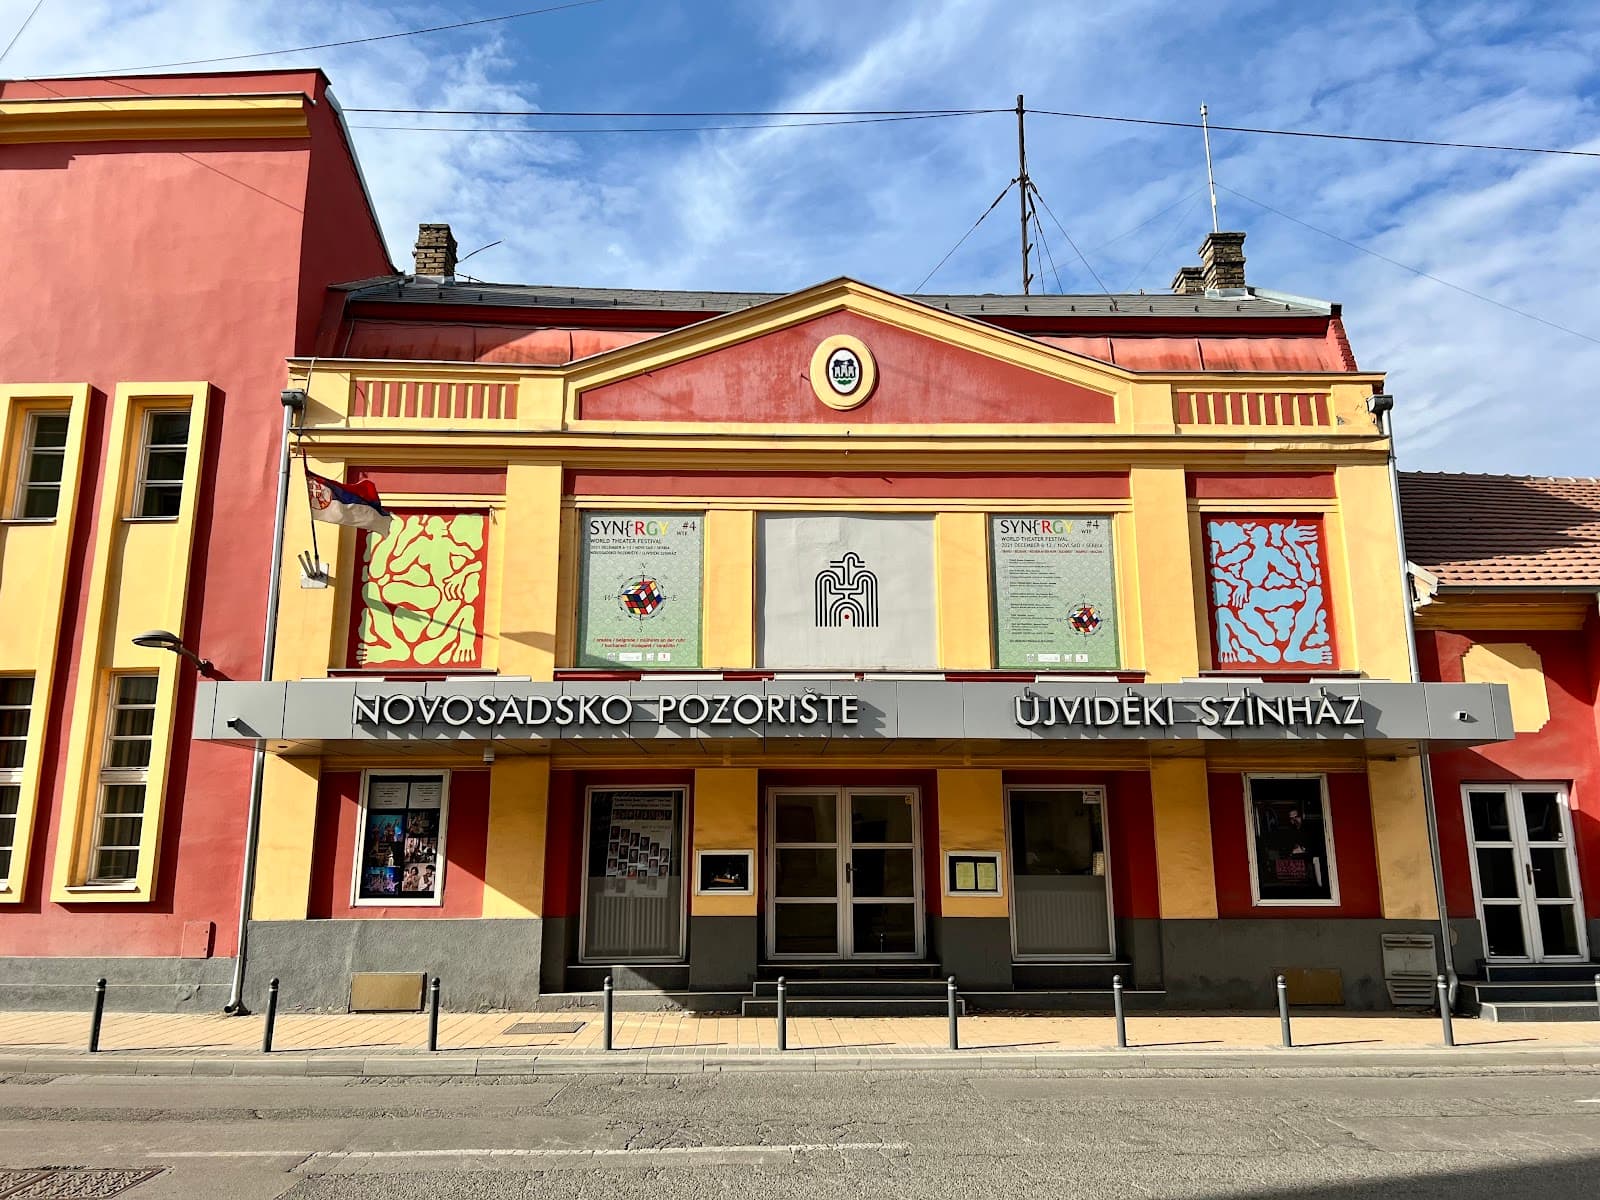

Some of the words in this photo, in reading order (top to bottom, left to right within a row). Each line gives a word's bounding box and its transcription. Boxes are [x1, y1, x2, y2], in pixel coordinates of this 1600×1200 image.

[682, 521, 697, 532] #4
[1086, 519, 1100, 529] #4
[352, 694, 633, 726] NOVOSADSKO
[658, 687, 859, 725] POZORIŠTE
[1014, 687, 1175, 726] ÚJVIDÉKI
[1199, 687, 1366, 726] SZÍNHÁZ
